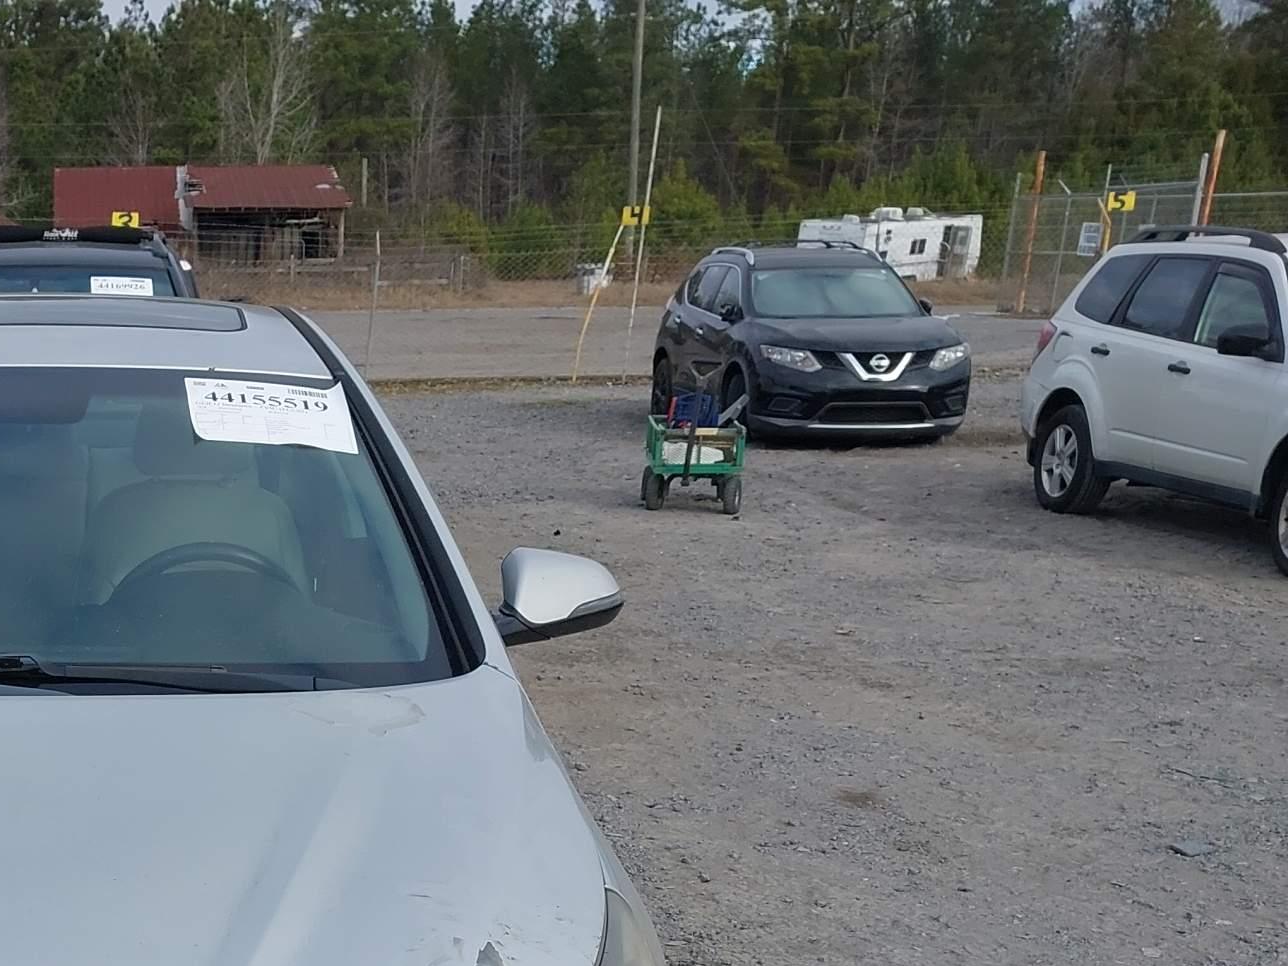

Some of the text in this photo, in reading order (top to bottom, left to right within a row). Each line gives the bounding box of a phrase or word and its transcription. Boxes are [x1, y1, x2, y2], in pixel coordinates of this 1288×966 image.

[1112, 191, 1128, 210] 5
[631, 207, 643, 225] 4
[204, 391, 329, 412] 44155519
